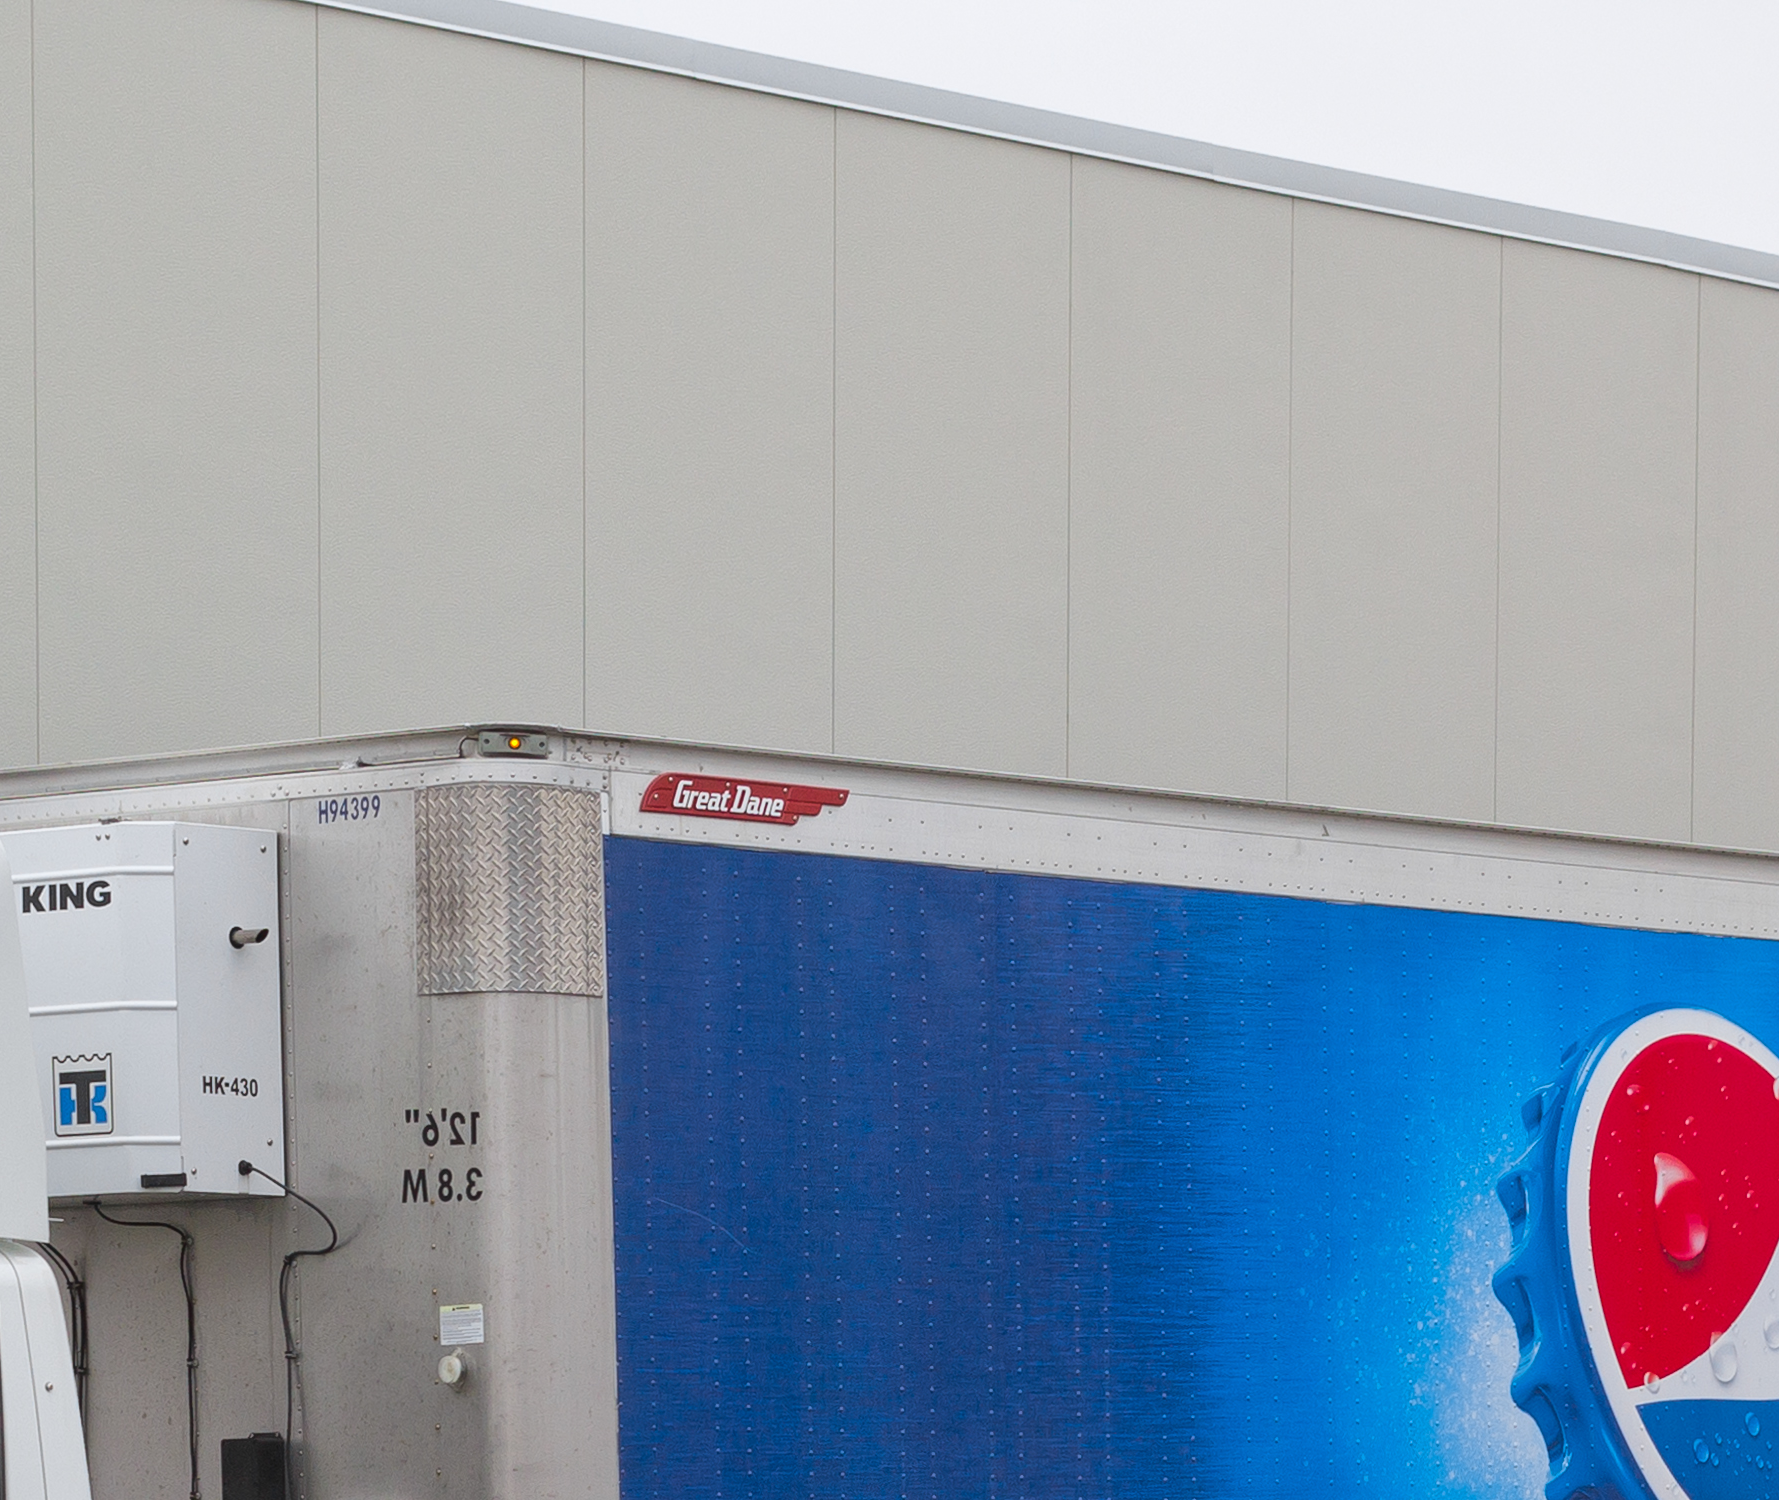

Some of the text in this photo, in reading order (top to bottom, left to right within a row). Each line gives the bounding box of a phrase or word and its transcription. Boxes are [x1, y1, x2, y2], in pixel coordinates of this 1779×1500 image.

[318, 795, 381, 824] H94399
[673, 779, 785, 817] Great Dane
[21, 880, 113, 914] KING
[201, 1075, 259, 1097] HK-430
